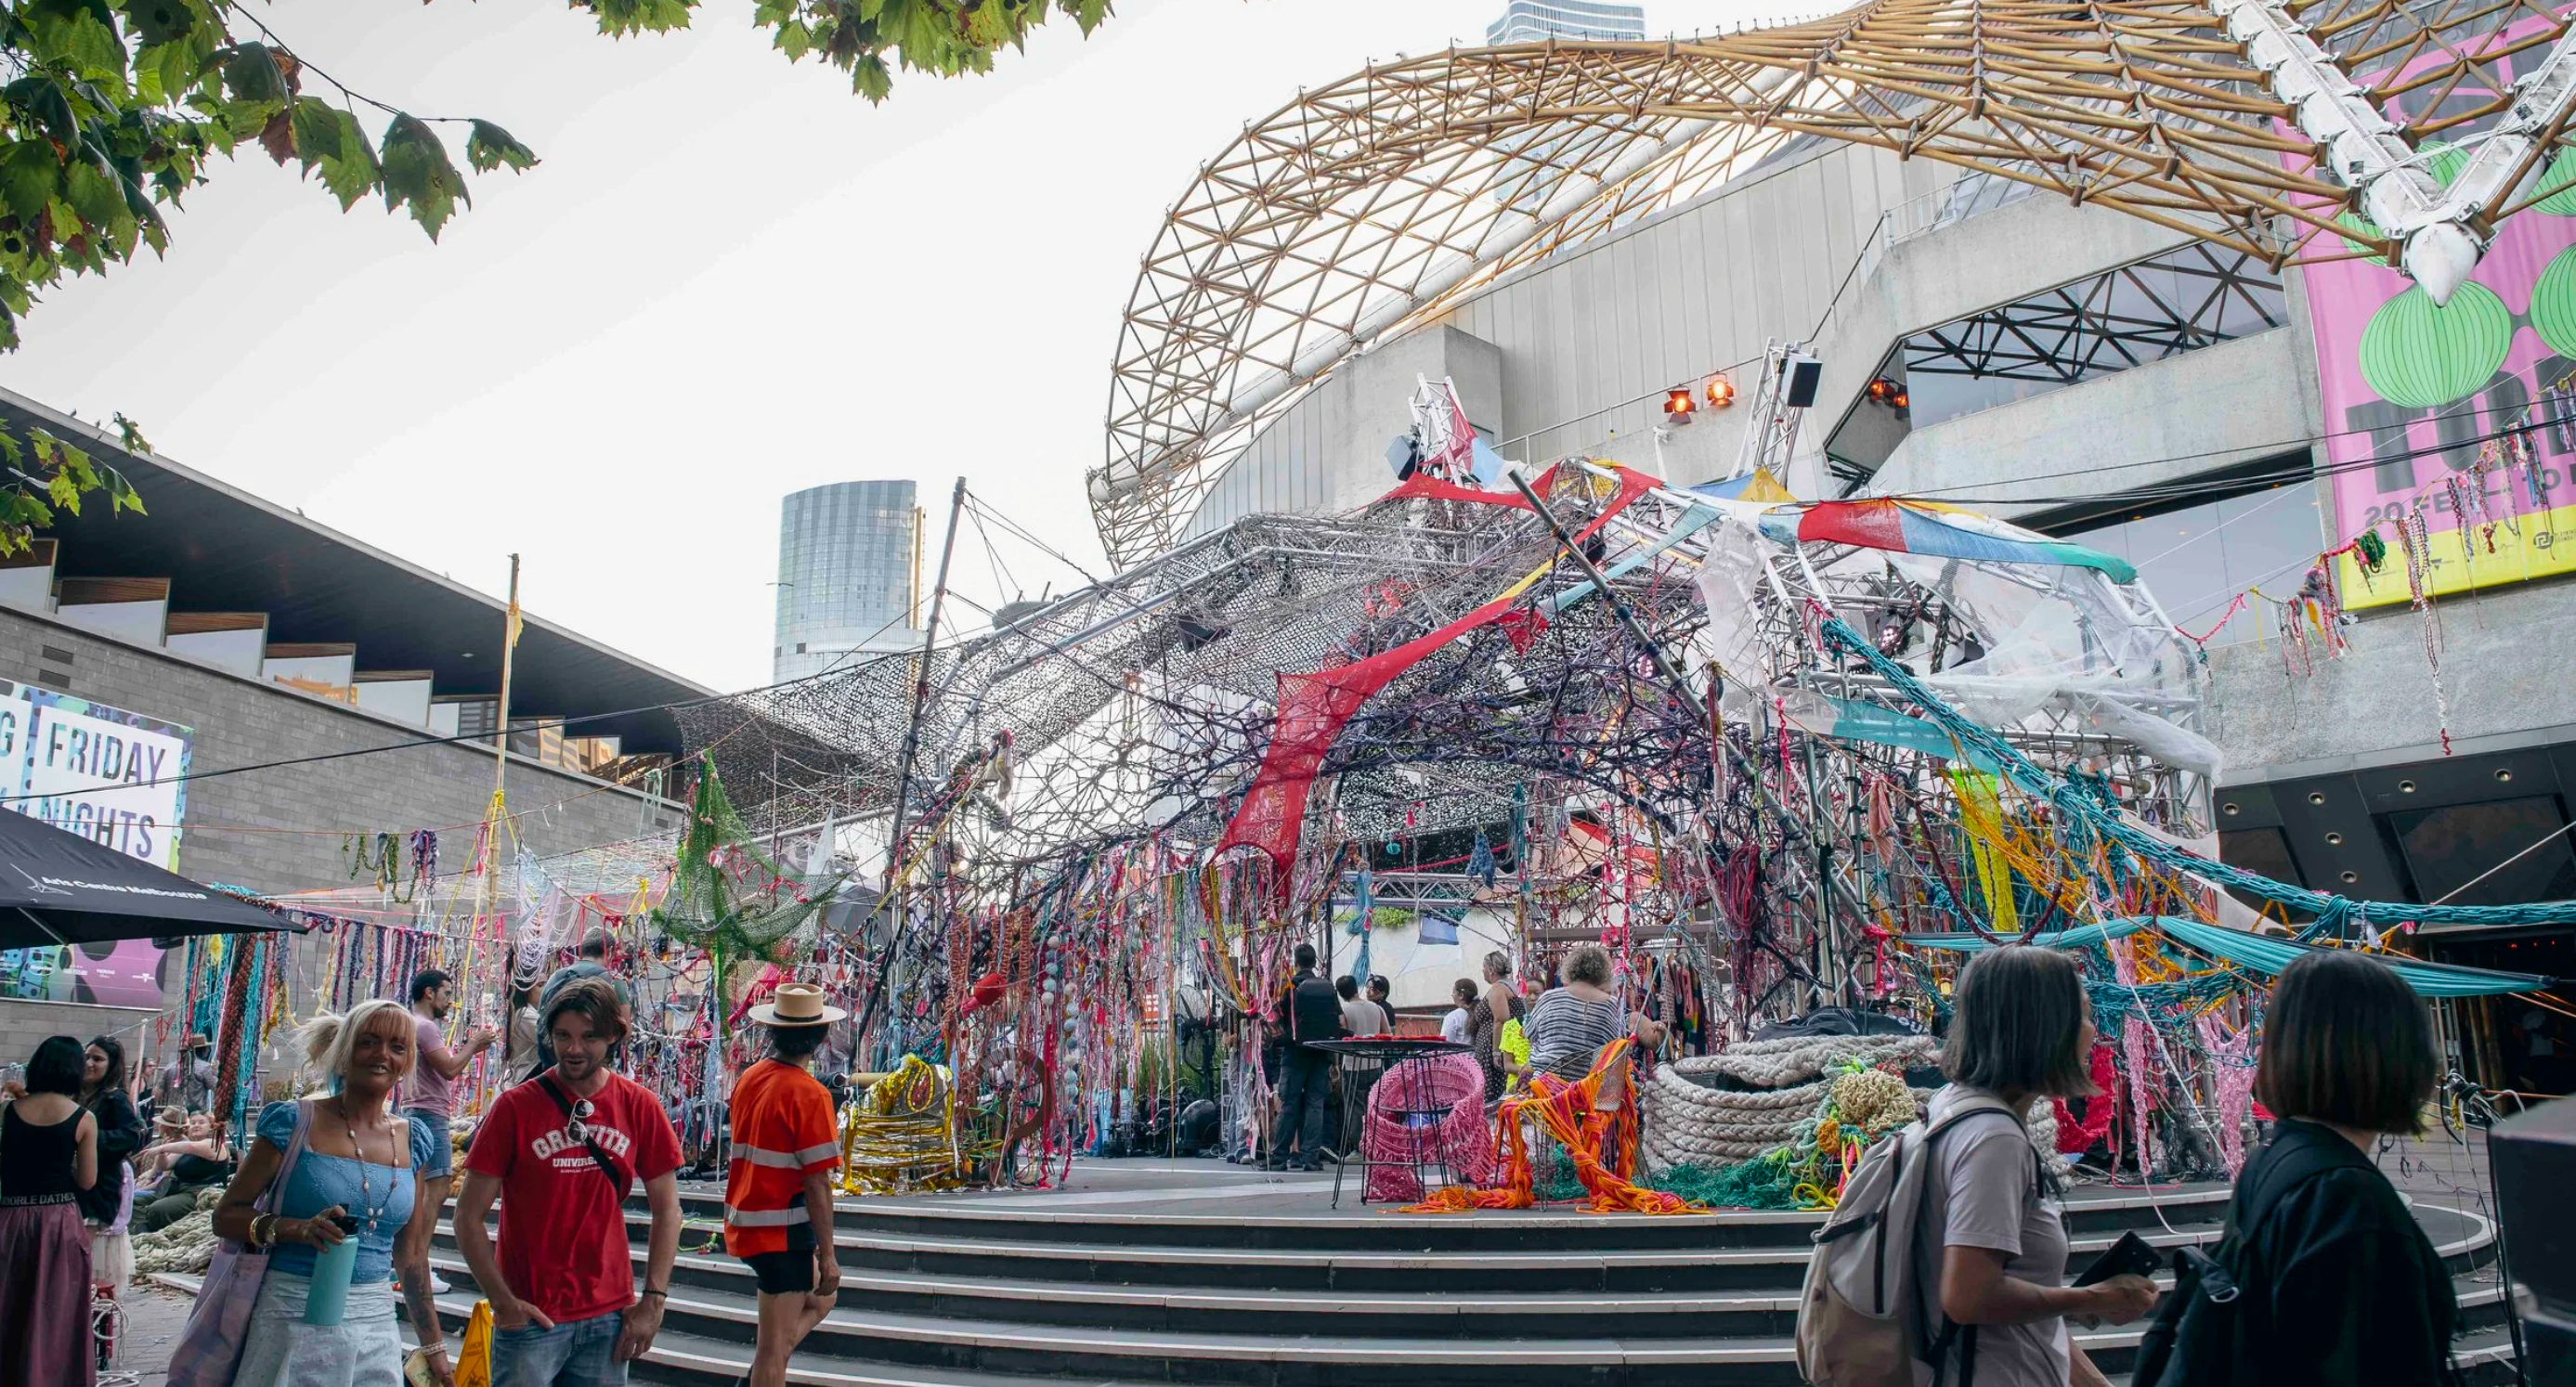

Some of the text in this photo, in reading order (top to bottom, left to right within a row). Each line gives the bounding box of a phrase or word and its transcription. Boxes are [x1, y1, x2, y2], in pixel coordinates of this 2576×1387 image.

[47, 721, 166, 789] FRIDAY
[40, 796, 156, 859] NIGHTS
[42, 876, 207, 900] Arts Centre Melbourne
